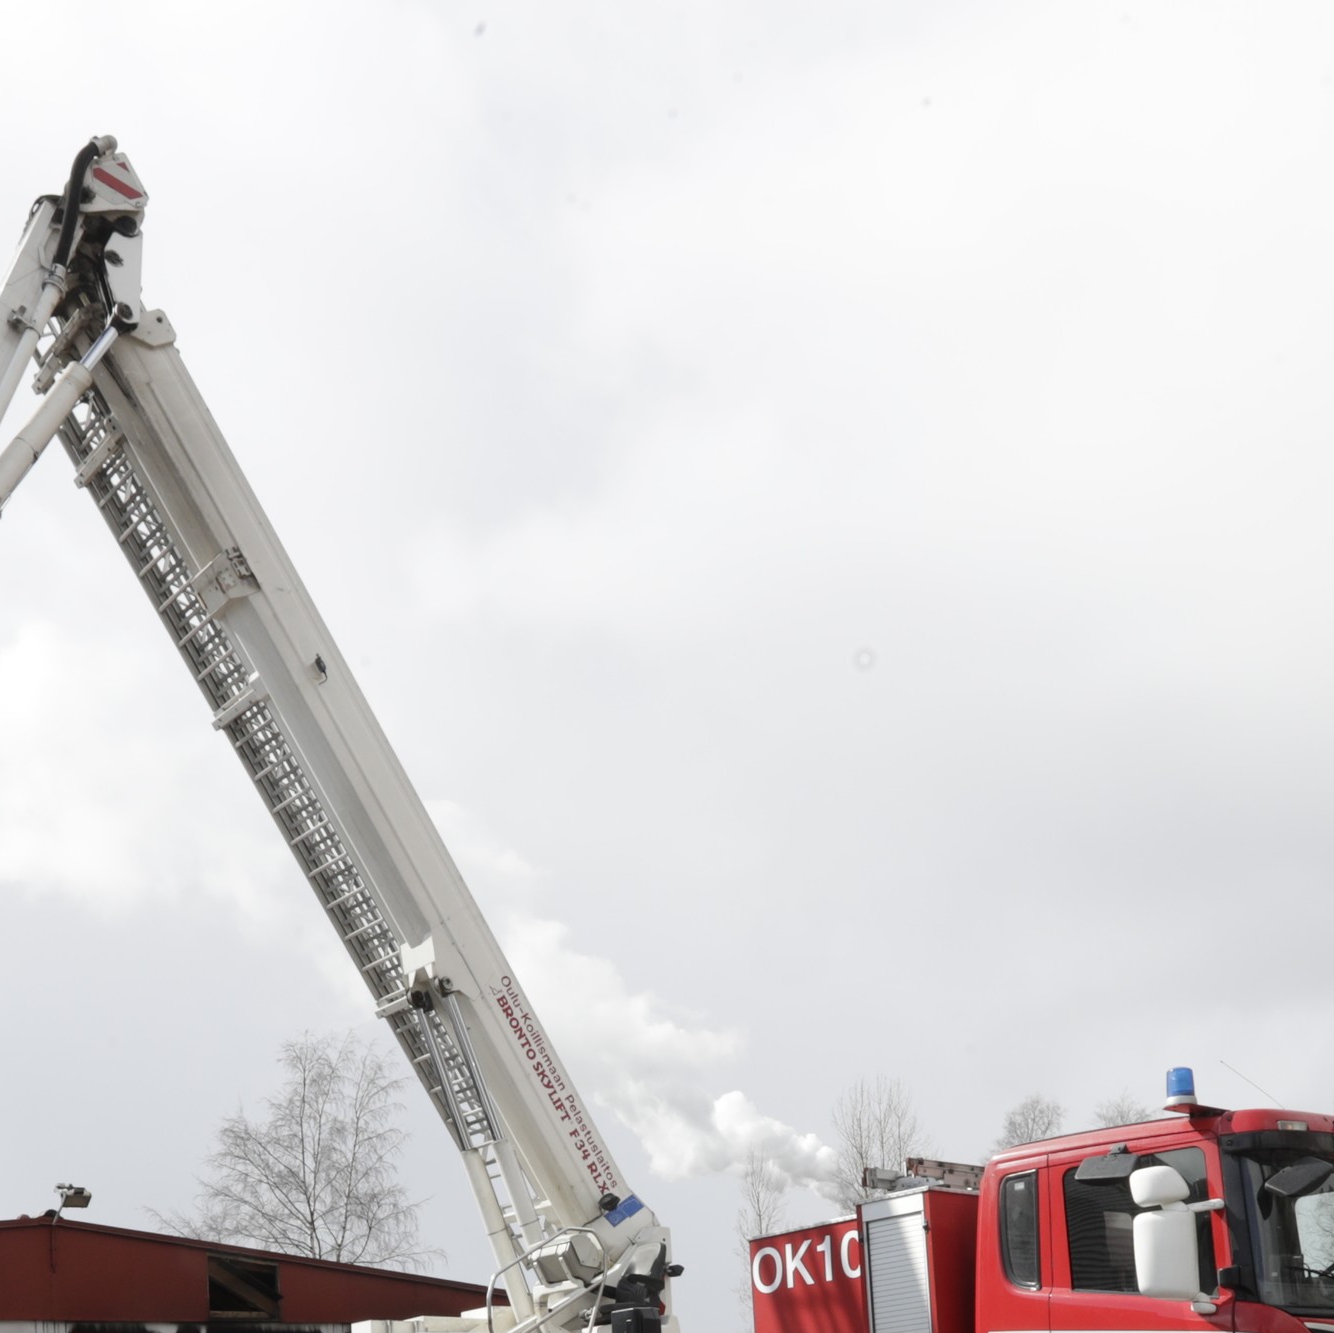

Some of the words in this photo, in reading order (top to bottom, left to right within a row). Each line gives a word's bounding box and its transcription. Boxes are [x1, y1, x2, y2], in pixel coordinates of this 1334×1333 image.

[497, 996, 536, 1059] BRONTO
[533, 1062, 571, 1121] SKYLIFT
[587, 1162, 611, 1198] RLX
[501, 976, 565, 1091] Oulu-Koillismaan
[565, 1094, 617, 1188] Pelastuslaitos
